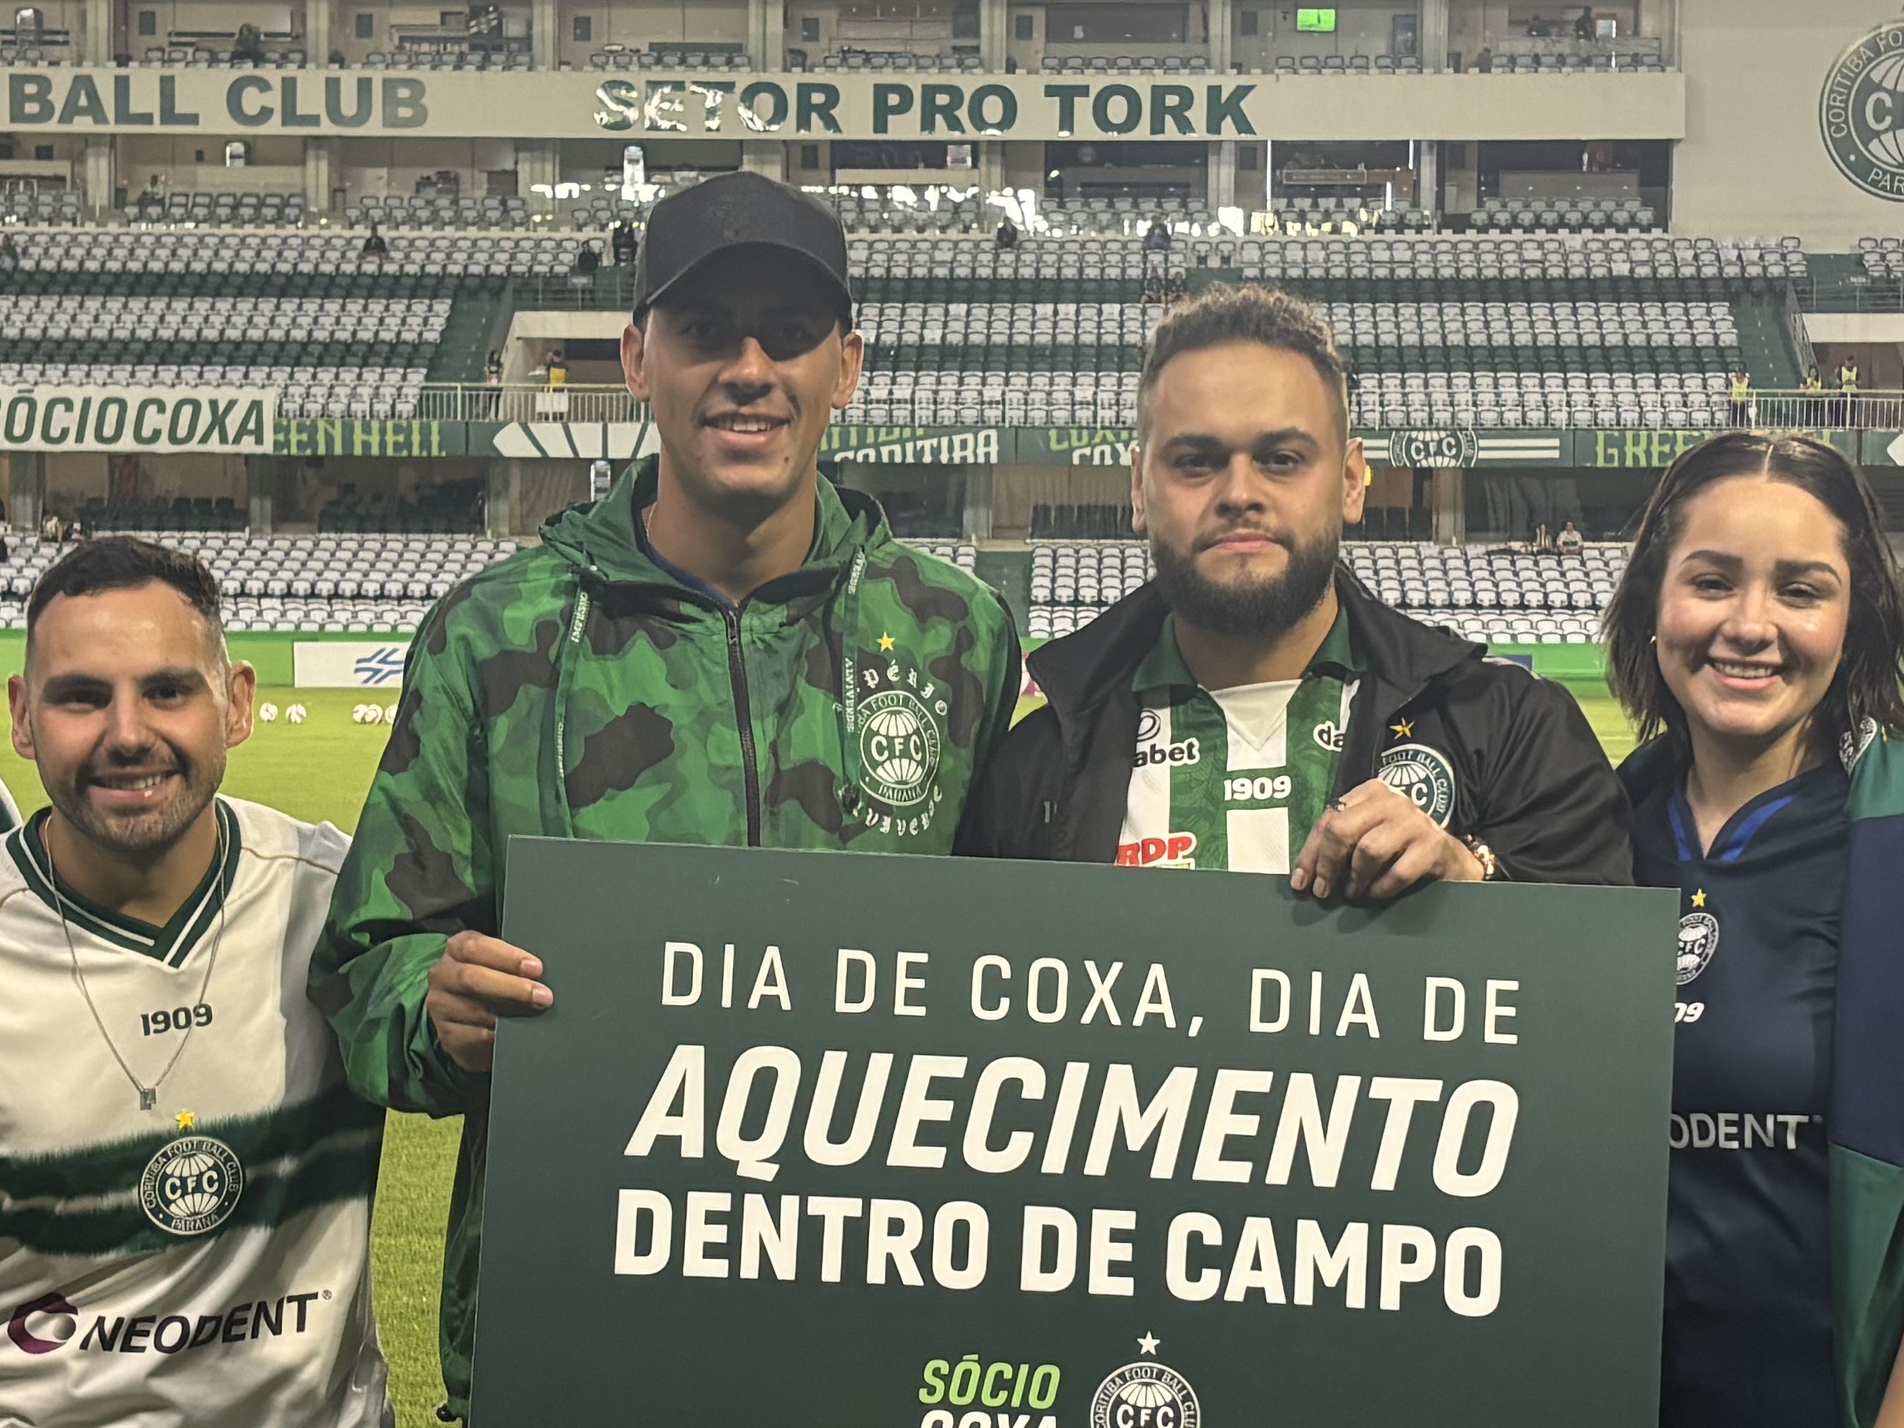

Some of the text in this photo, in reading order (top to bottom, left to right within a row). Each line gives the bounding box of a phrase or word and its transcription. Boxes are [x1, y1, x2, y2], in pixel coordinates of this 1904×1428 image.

[8, 72, 200, 128] BALL
[225, 75, 430, 130] CLUB
[592, 79, 842, 134] SETOR
[873, 83, 1018, 136] PRO
[1045, 84, 1258, 137] TORK
[1829, 46, 1875, 138] CORITIBA
[353, 420, 446, 456] HELL
[871, 735, 922, 762] CFC
[1224, 776, 1292, 801] 1909
[141, 1003, 214, 1037] 1909
[661, 941, 1521, 1045] DIA DE COXA, DIA DE
[625, 1045, 1520, 1198] AQUECIMENTO
[165, 1170, 219, 1201] CFC
[614, 1189, 1503, 1318] DENTRO DE CAMPO
[79, 1292, 319, 1355] NEODENT
[918, 1353, 1061, 1409] SÓCIO
[1125, 1367, 1160, 1382] FOOT
[1161, 1372, 1188, 1400] BALL
